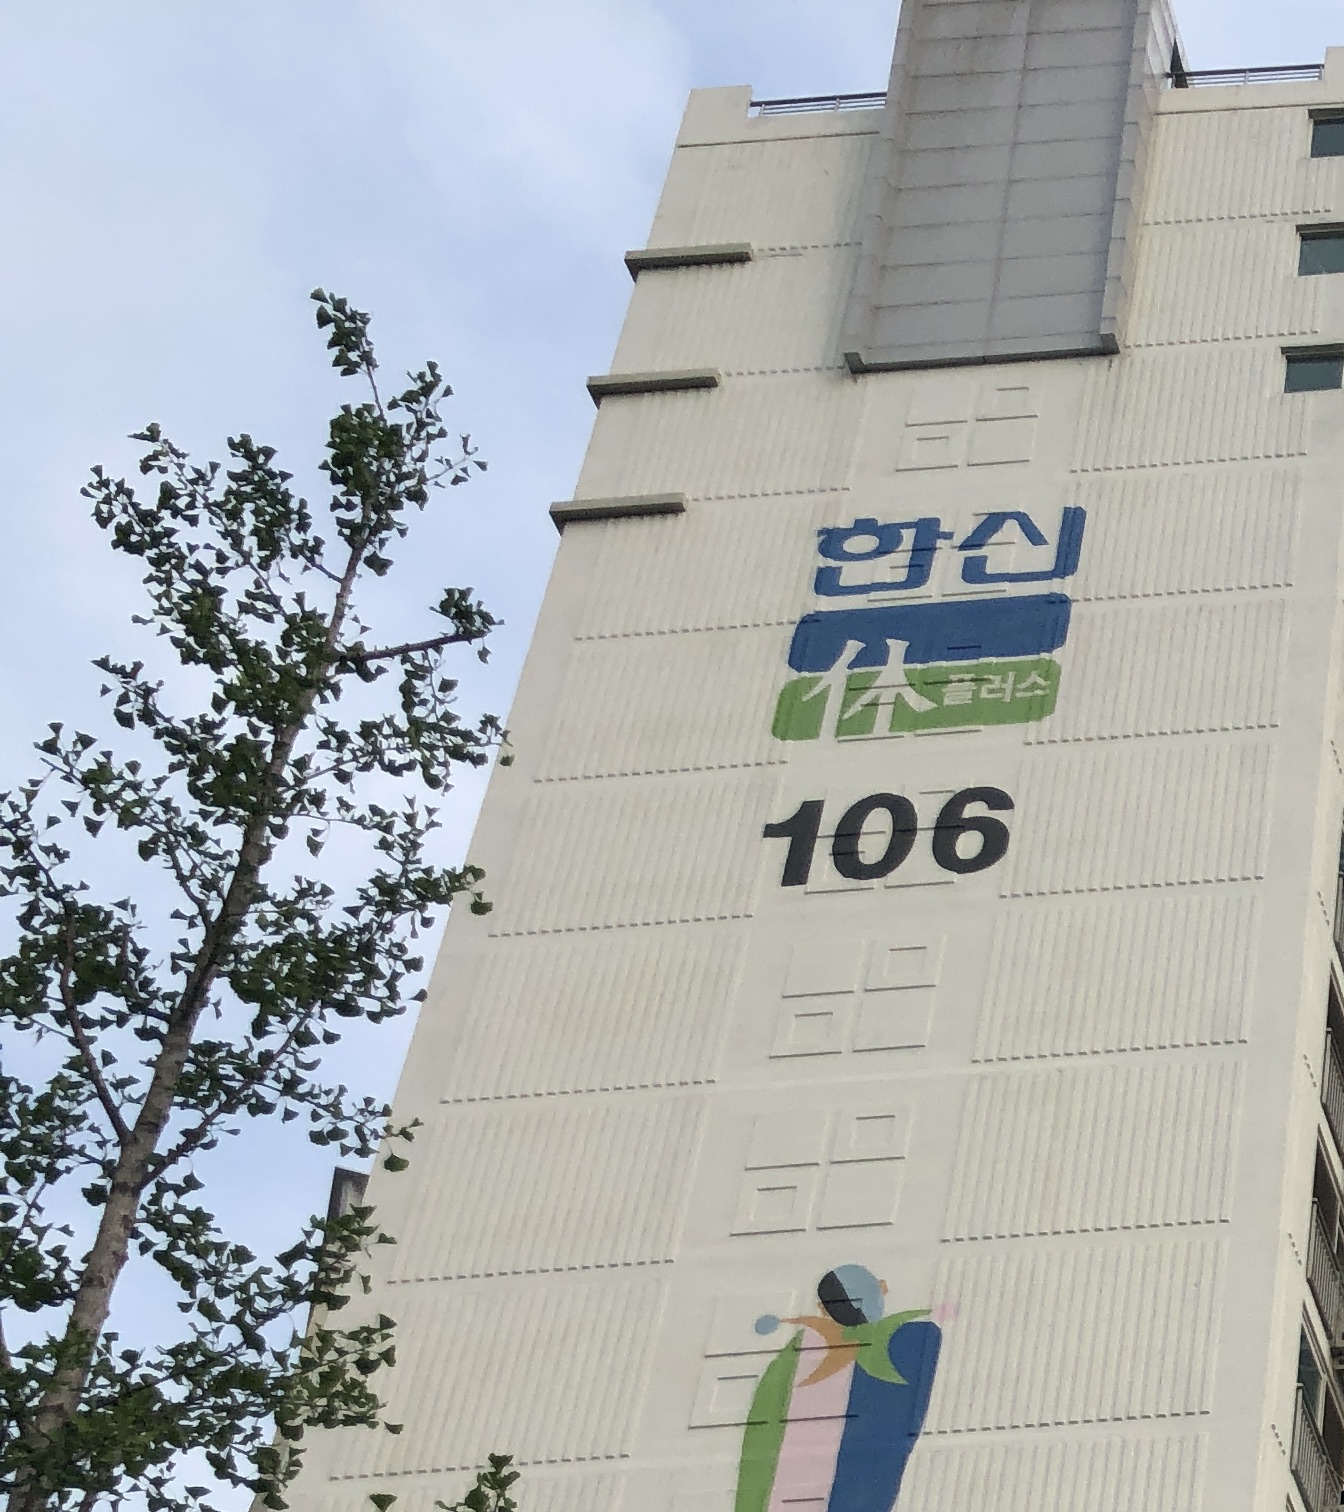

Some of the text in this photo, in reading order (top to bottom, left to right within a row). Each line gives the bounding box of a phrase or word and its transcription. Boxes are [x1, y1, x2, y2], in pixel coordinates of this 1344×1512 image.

[813, 506, 1087, 597] 한신
[942, 670, 1051, 706] 플러스
[762, 786, 1015, 887] 106
